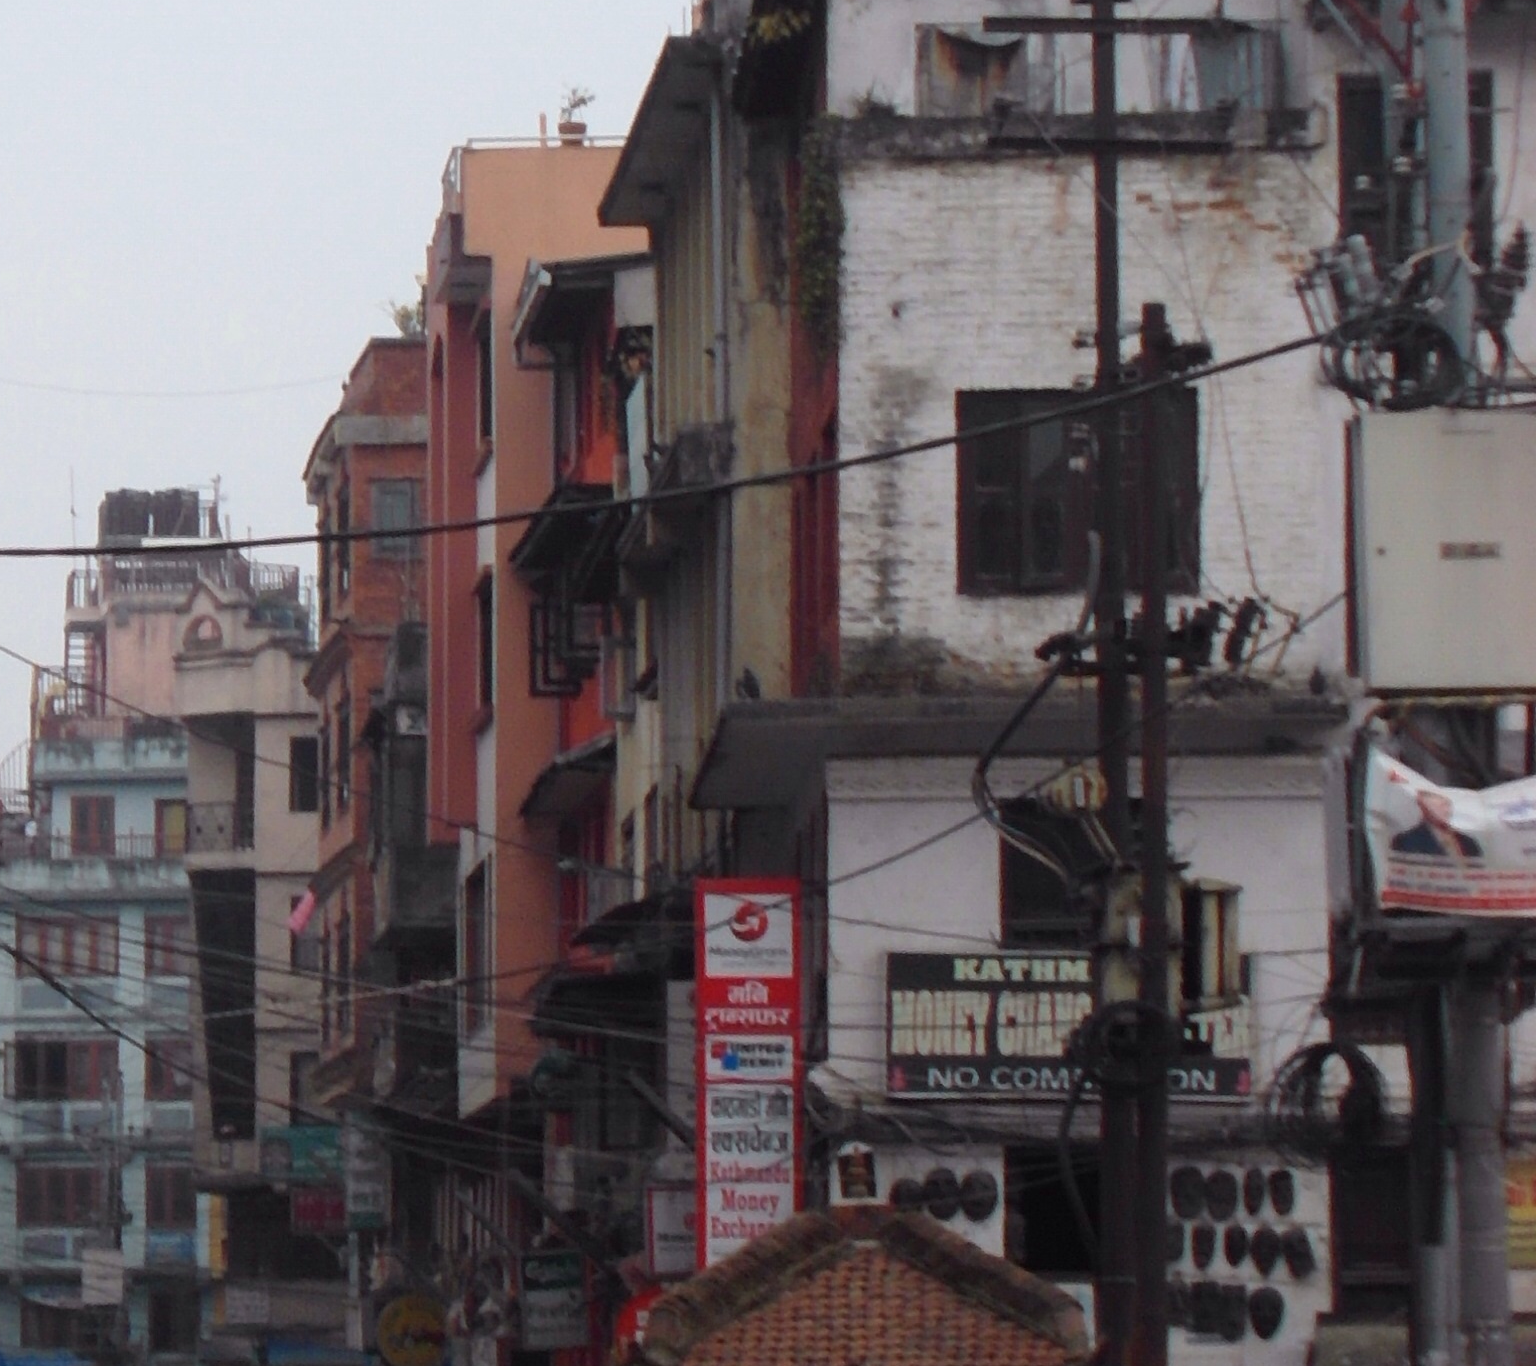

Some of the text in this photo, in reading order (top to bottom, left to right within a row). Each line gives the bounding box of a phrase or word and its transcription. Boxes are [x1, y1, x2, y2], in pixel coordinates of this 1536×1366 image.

[953, 957, 1092, 985] KATHM
[890, 989, 992, 1057] MONEY
[927, 1065, 980, 1092] NO
[710, 1161, 791, 1184] Kathmandu
[720, 1189, 781, 1218] Money
